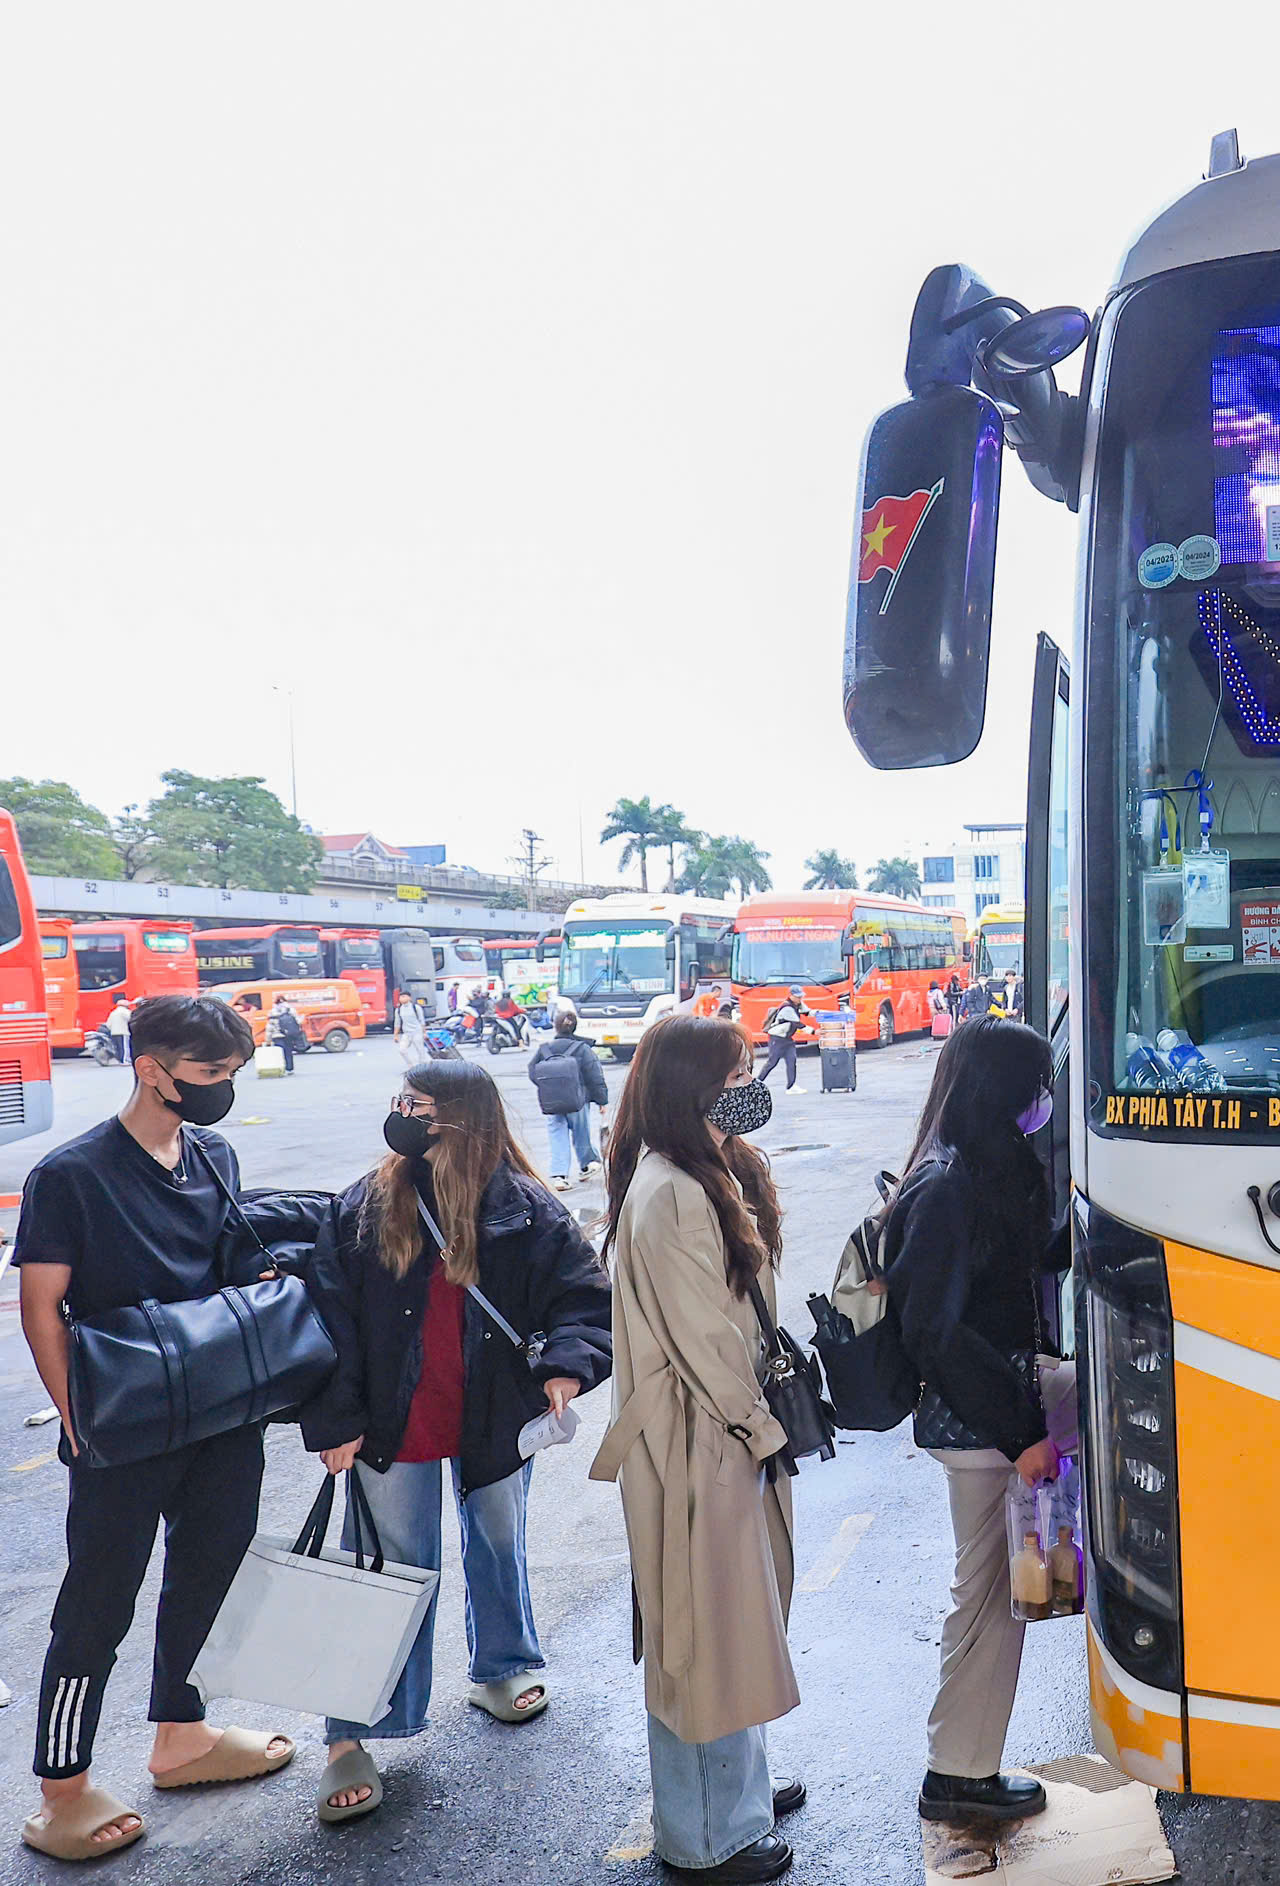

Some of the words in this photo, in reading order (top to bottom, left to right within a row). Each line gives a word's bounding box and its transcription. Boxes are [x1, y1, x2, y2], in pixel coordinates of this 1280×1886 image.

[1145, 553, 1174, 567] 04/2025
[84, 882, 97, 893] 52
[157, 887, 168, 897] 53
[221, 891, 231, 901] 54
[279, 895, 288, 905] 55
[329, 899, 339, 908] 56
[375, 902, 383, 911] 57
[1250, 917, 1269, 925] BÌNH
[196, 956, 254, 967] USINE
[1106, 1095, 1126, 1124] BX
[1128, 1089, 1168, 1126] PHÍA
[1173, 1092, 1208, 1128] TÂY
[1212, 1099, 1241, 1129] T.H
